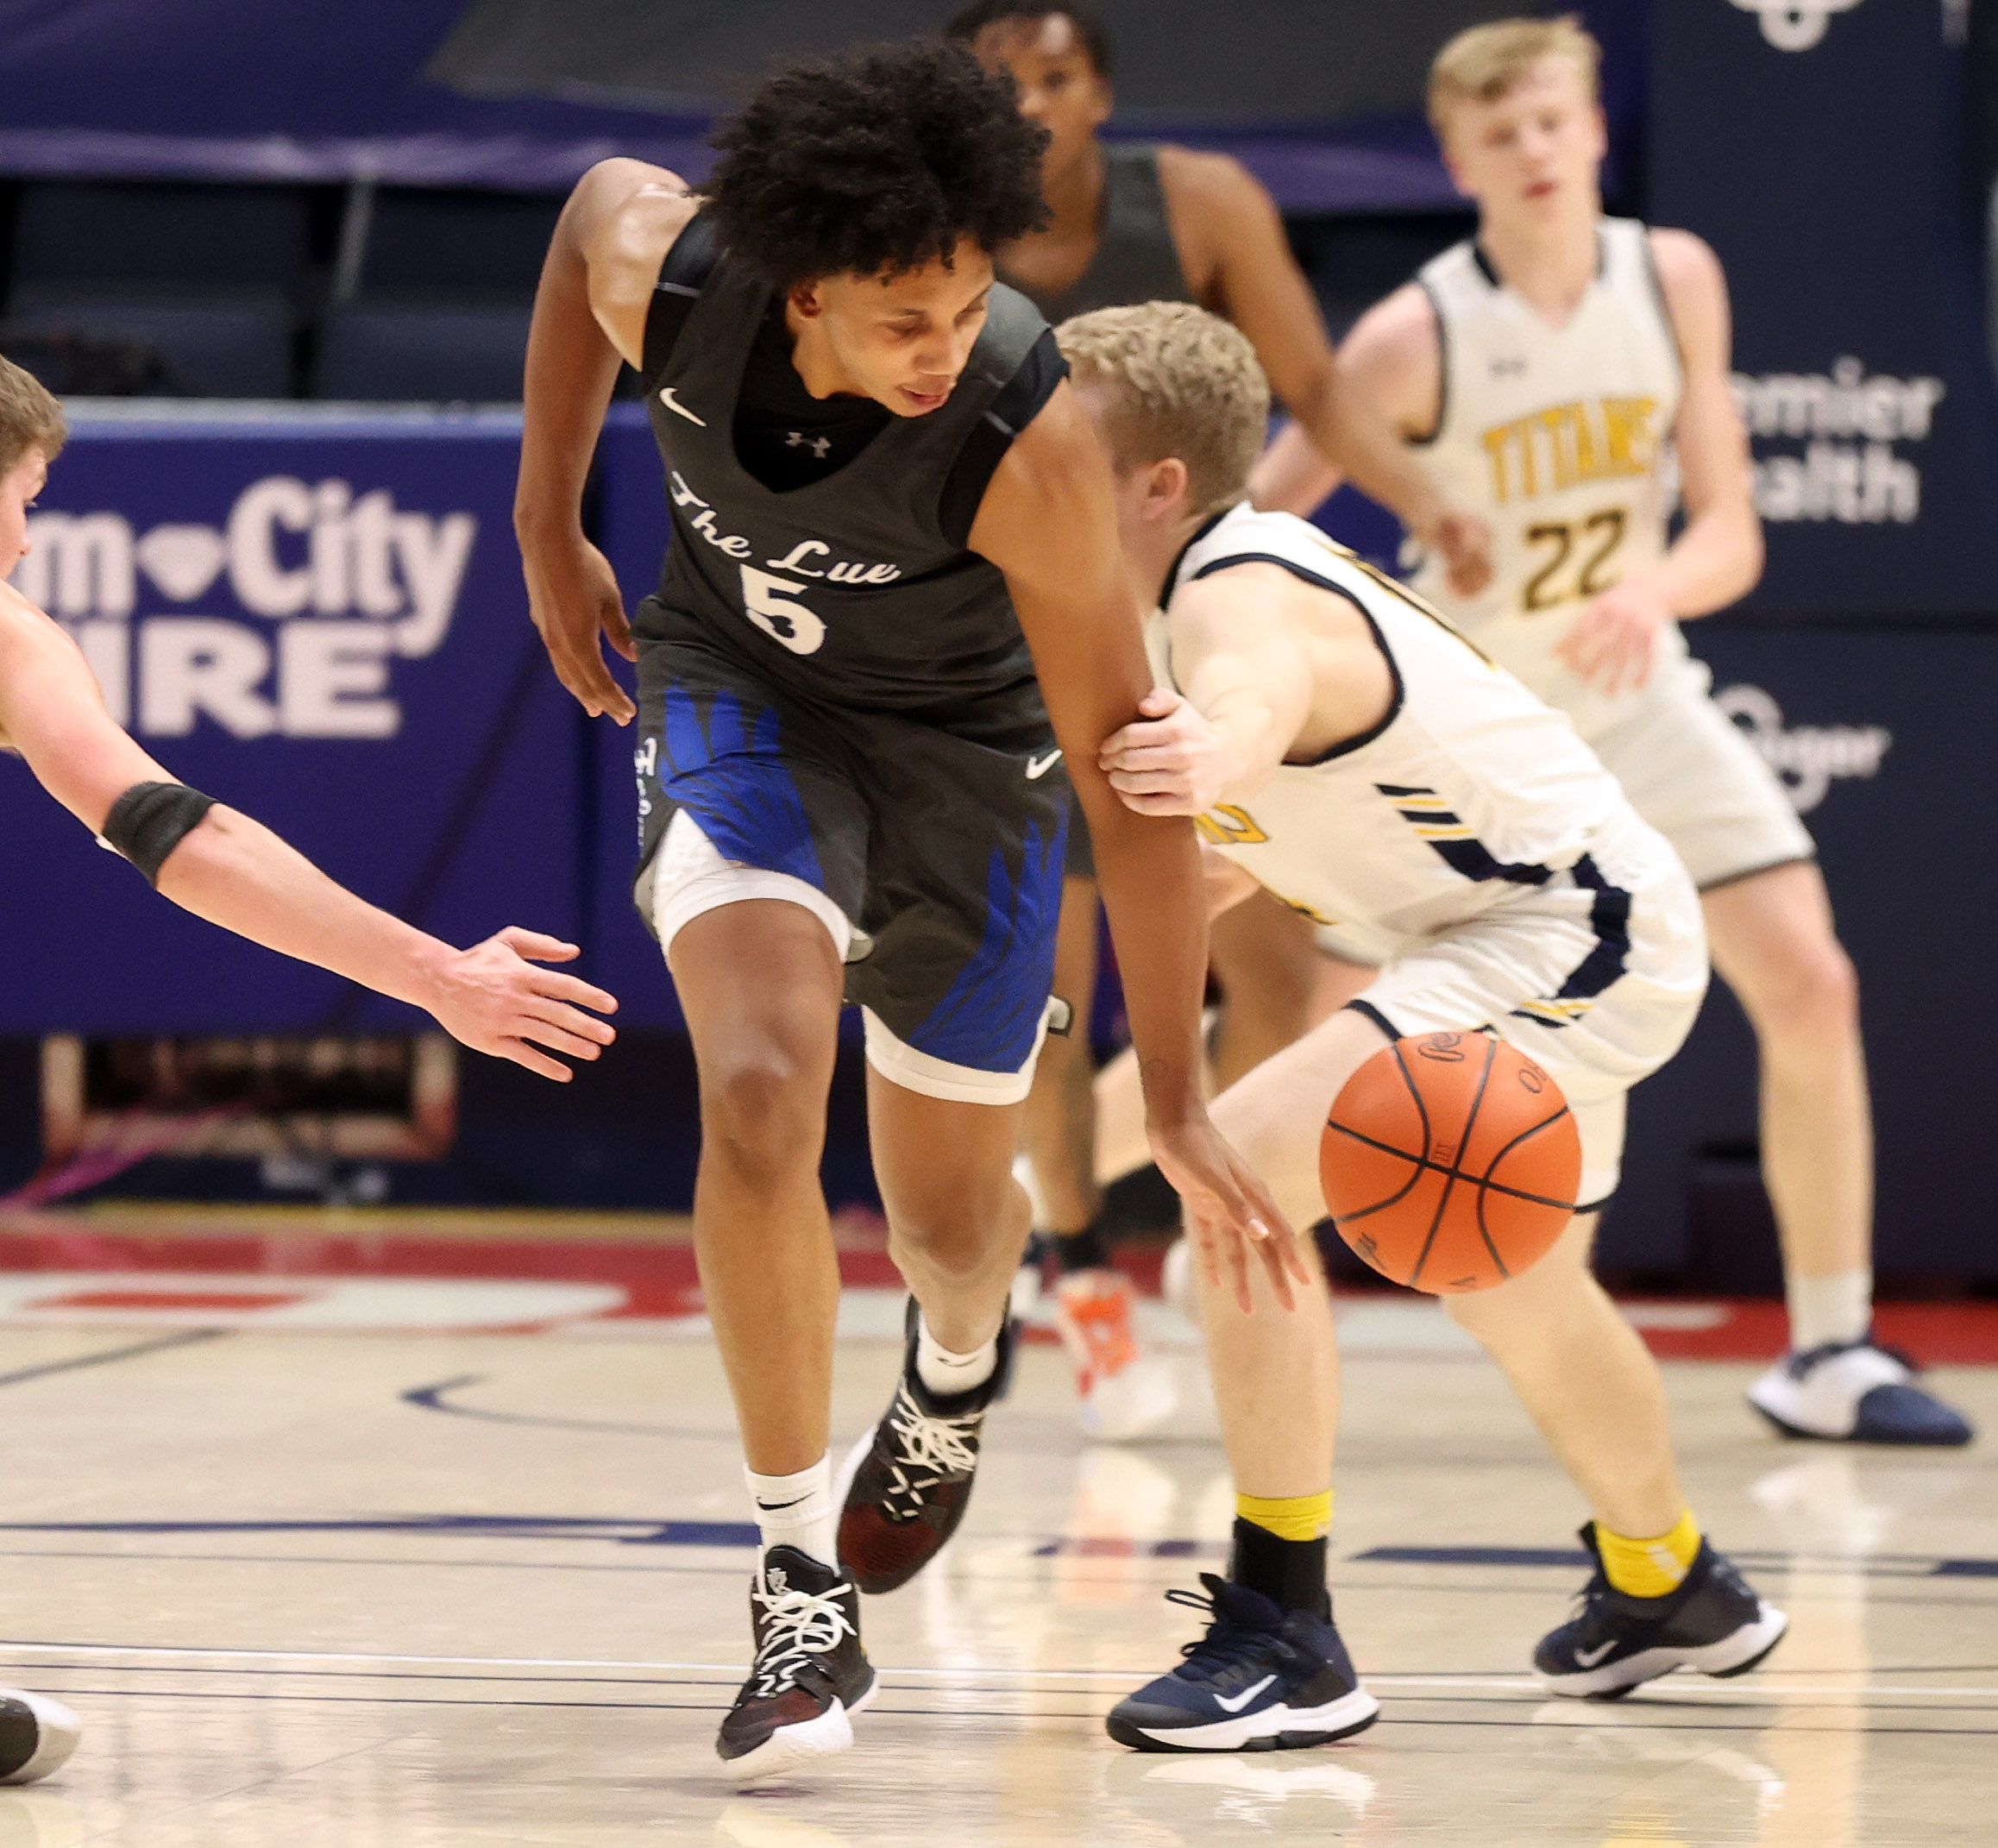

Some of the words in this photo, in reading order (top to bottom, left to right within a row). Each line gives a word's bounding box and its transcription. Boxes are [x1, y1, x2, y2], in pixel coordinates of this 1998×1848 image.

[1480, 396, 1660, 502] TITANS
[1751, 438, 1919, 524] alth
[228, 474, 476, 659] City
[669, 470, 752, 558] The
[765, 539, 902, 584] Lue
[1523, 507, 1627, 614] 22
[739, 563, 828, 656] 5
[67, 613, 401, 740] IRE
